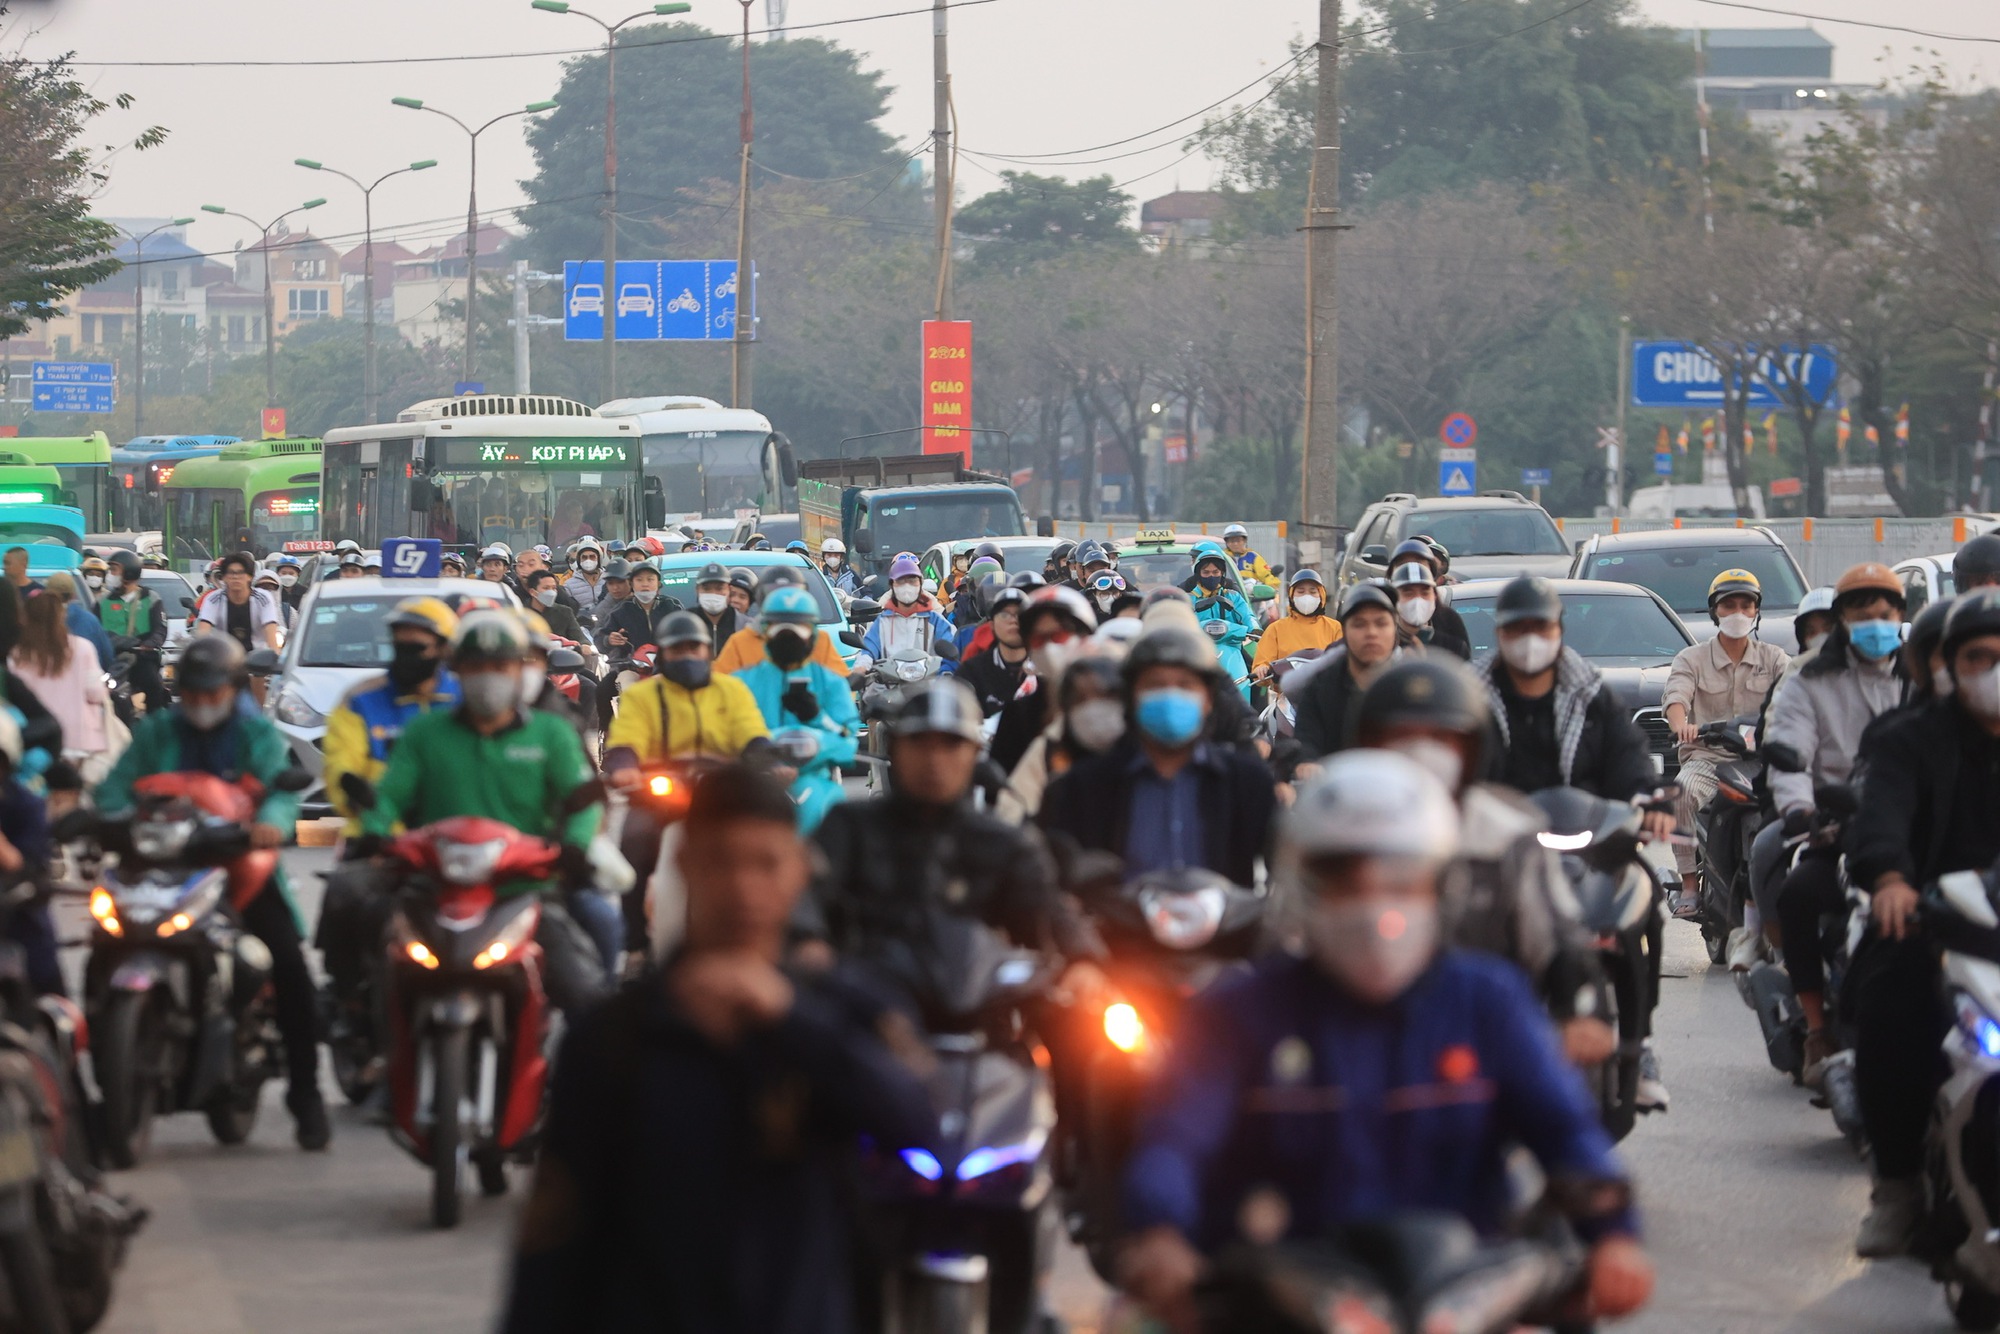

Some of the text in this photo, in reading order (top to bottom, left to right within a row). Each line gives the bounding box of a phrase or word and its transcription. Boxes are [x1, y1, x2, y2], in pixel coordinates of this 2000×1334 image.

[929, 346, 966, 359] 2024
[1142, 530, 1169, 538] TAXI
[287, 541, 331, 551] Taxi 123
